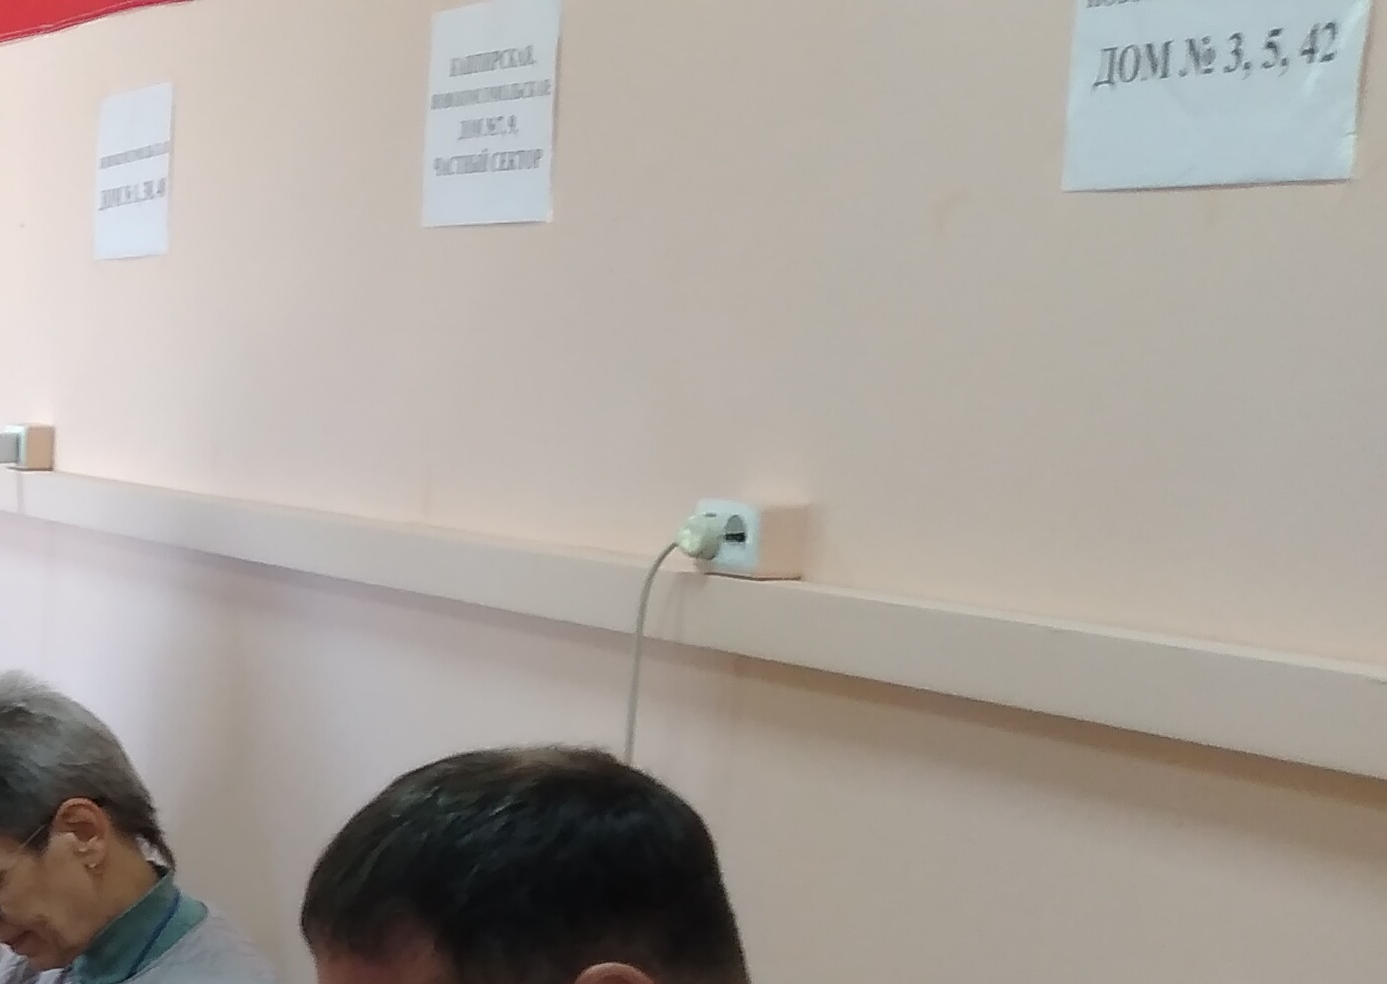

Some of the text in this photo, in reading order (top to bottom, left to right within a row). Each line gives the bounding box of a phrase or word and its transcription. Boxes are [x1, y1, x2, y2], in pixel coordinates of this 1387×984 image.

[1091, 21, 1338, 90] ДОМ № 3, 5, 42
